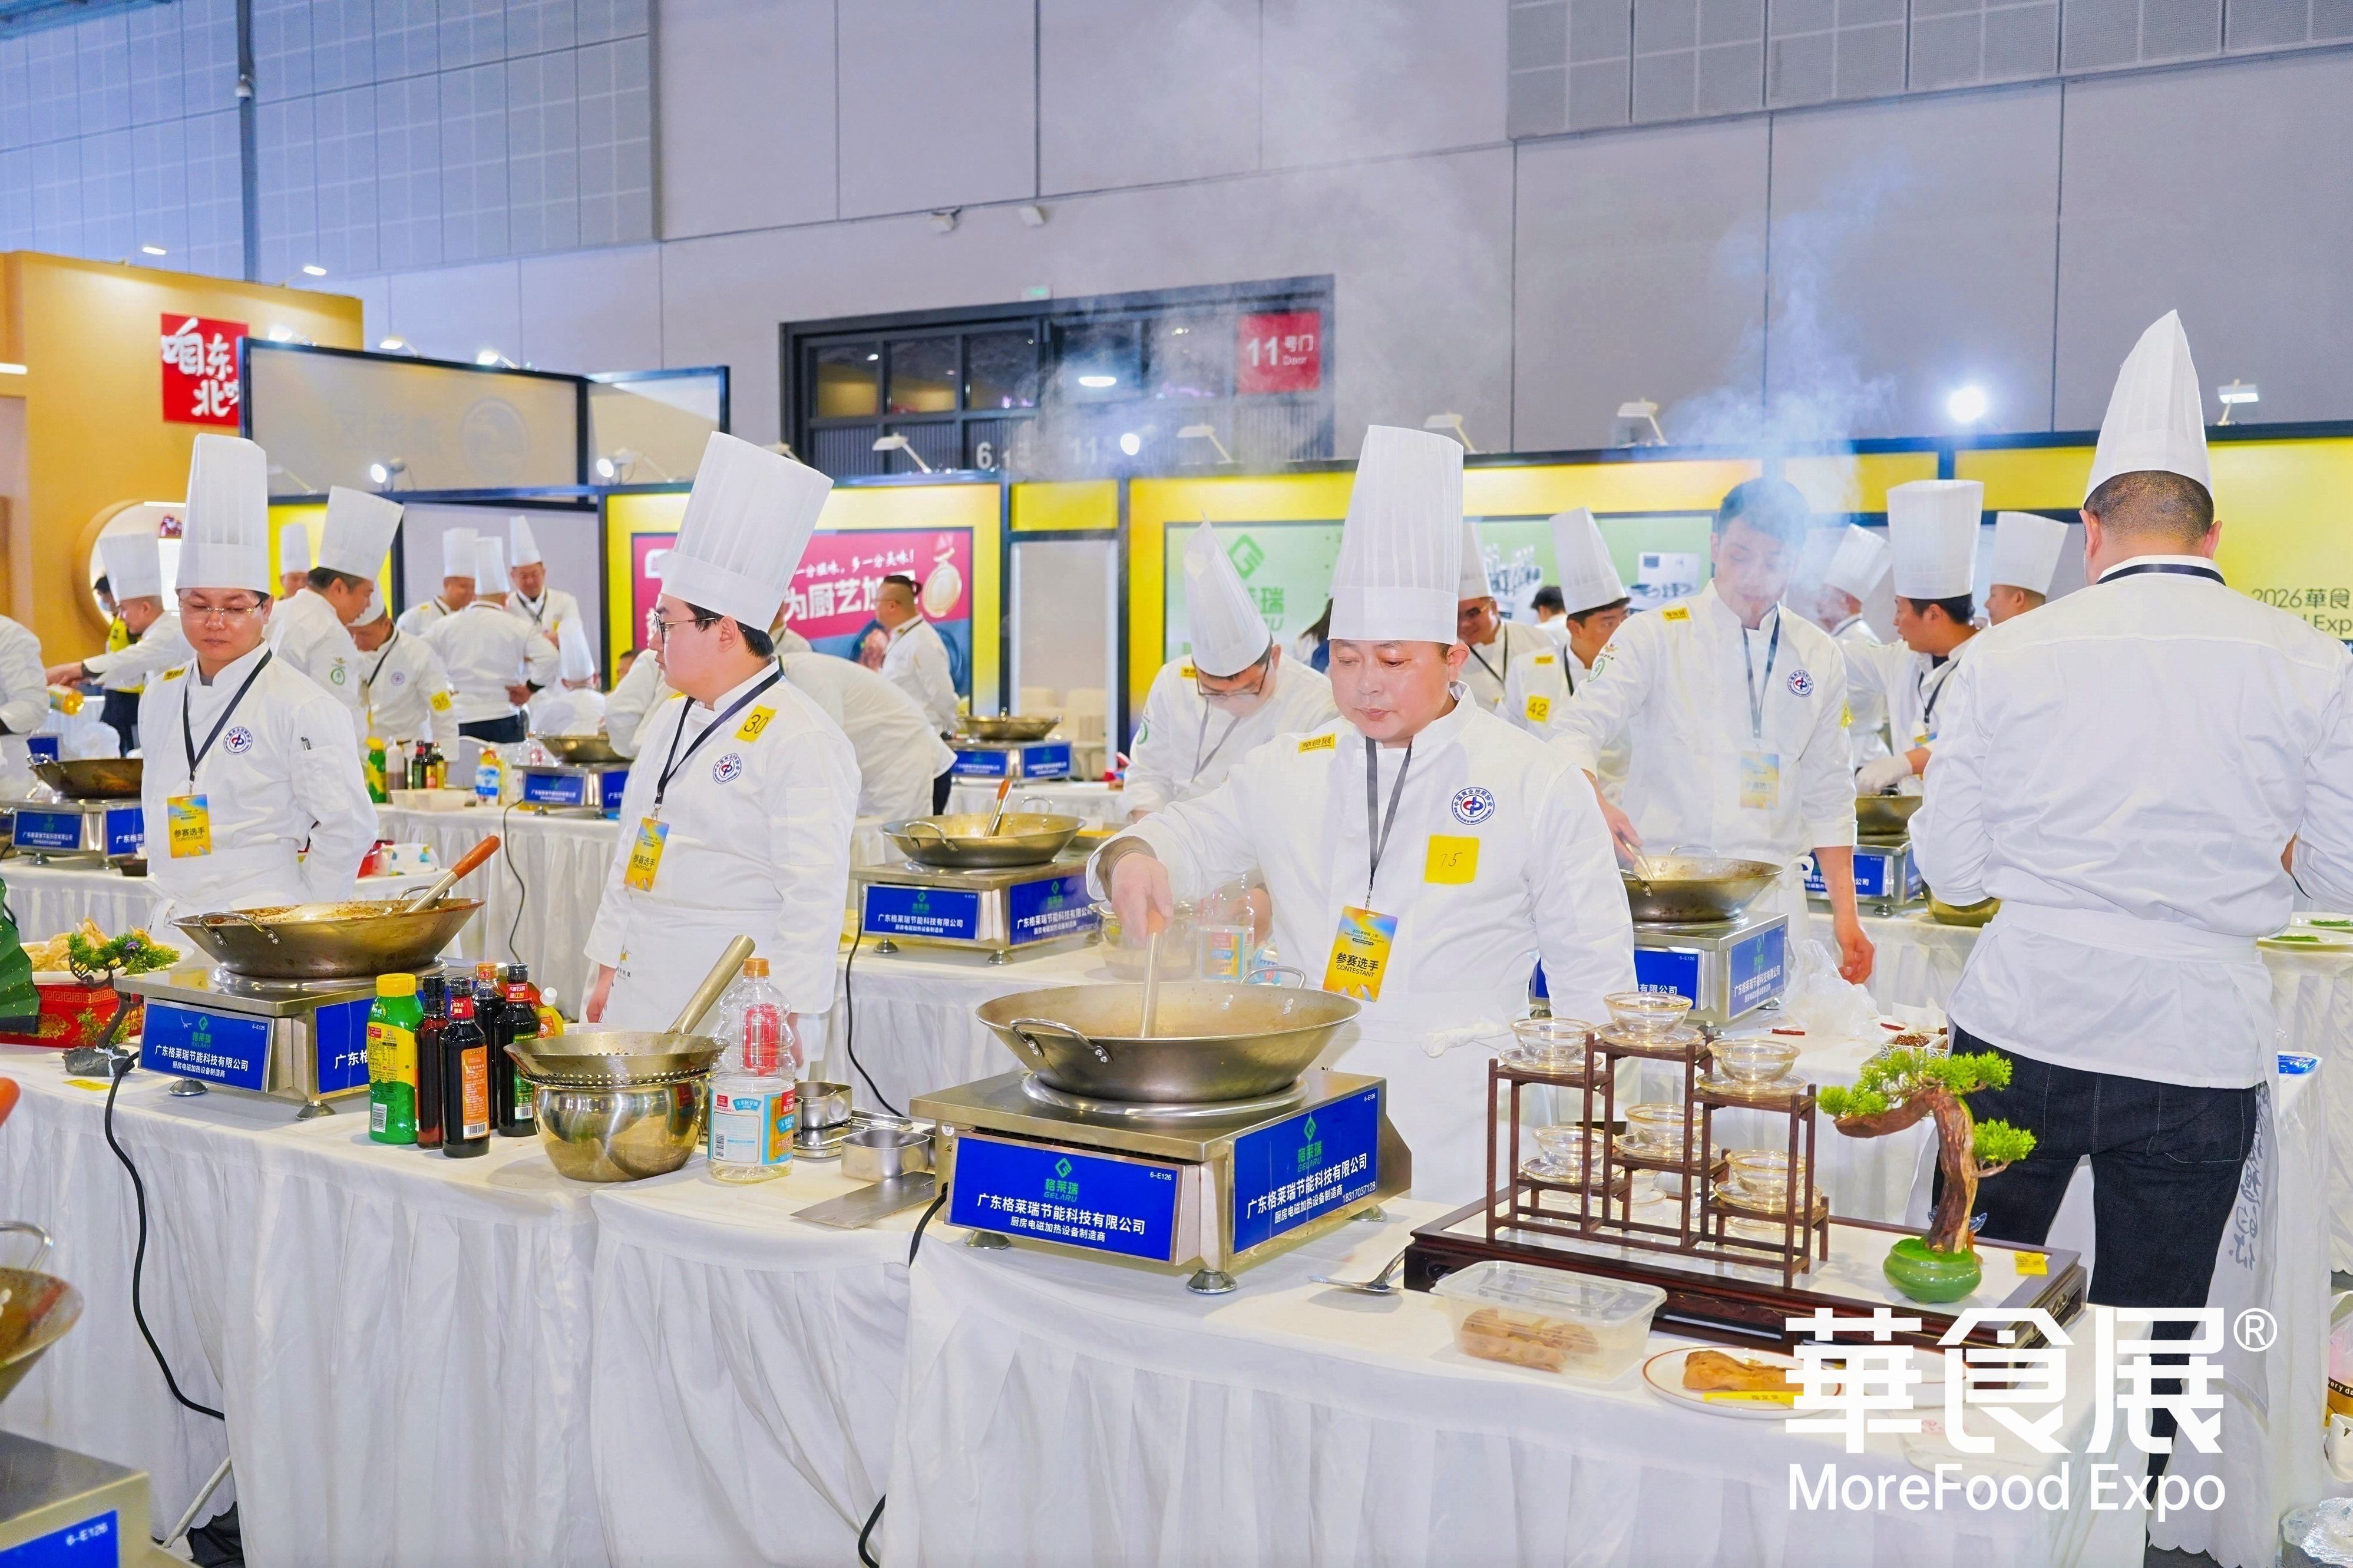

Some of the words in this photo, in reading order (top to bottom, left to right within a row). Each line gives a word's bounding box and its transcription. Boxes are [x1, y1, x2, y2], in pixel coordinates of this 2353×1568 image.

[1247, 336, 1278, 366] 11
[1529, 703, 1547, 717] 42
[743, 714, 769, 734] 30
[174, 827, 205, 838] 参赛选手
[633, 854, 656, 867] 参赛选手
[878, 914, 963, 928] 广东格莱瑞节能科技有限公司
[1336, 952, 1379, 971] 参赛选手
[1336, 964, 1374, 977] CONTESTANT
[192, 1031, 211, 1044] 格莱瑞
[155, 1044, 249, 1071] 广东格莱瑞节能科技有限公司
[172, 1061, 226, 1078] 厨房电磁加热设备制造商
[1364, 1093, 1376, 1102] 6-E126
[1297, 1140, 1323, 1163] 格莱瑞
[1297, 1157, 1321, 1172] GELARU
[1149, 1171, 1172, 1180] 6-E126
[1045, 1178, 1079, 1195] 格莱瑞
[1247, 1153, 1367, 1219] 广东格莱瑞节能科技有限公司
[1342, 1181, 1376, 1203] 18317037128
[1043, 1191, 1078, 1202] GELARU
[1274, 1184, 1343, 1224] 厨房电磁加热设备制造商
[977, 1192, 1146, 1235] 广东格莱瑞节能科技有限公司
[1010, 1216, 1105, 1242] 厨房电磁加热设备制造商
